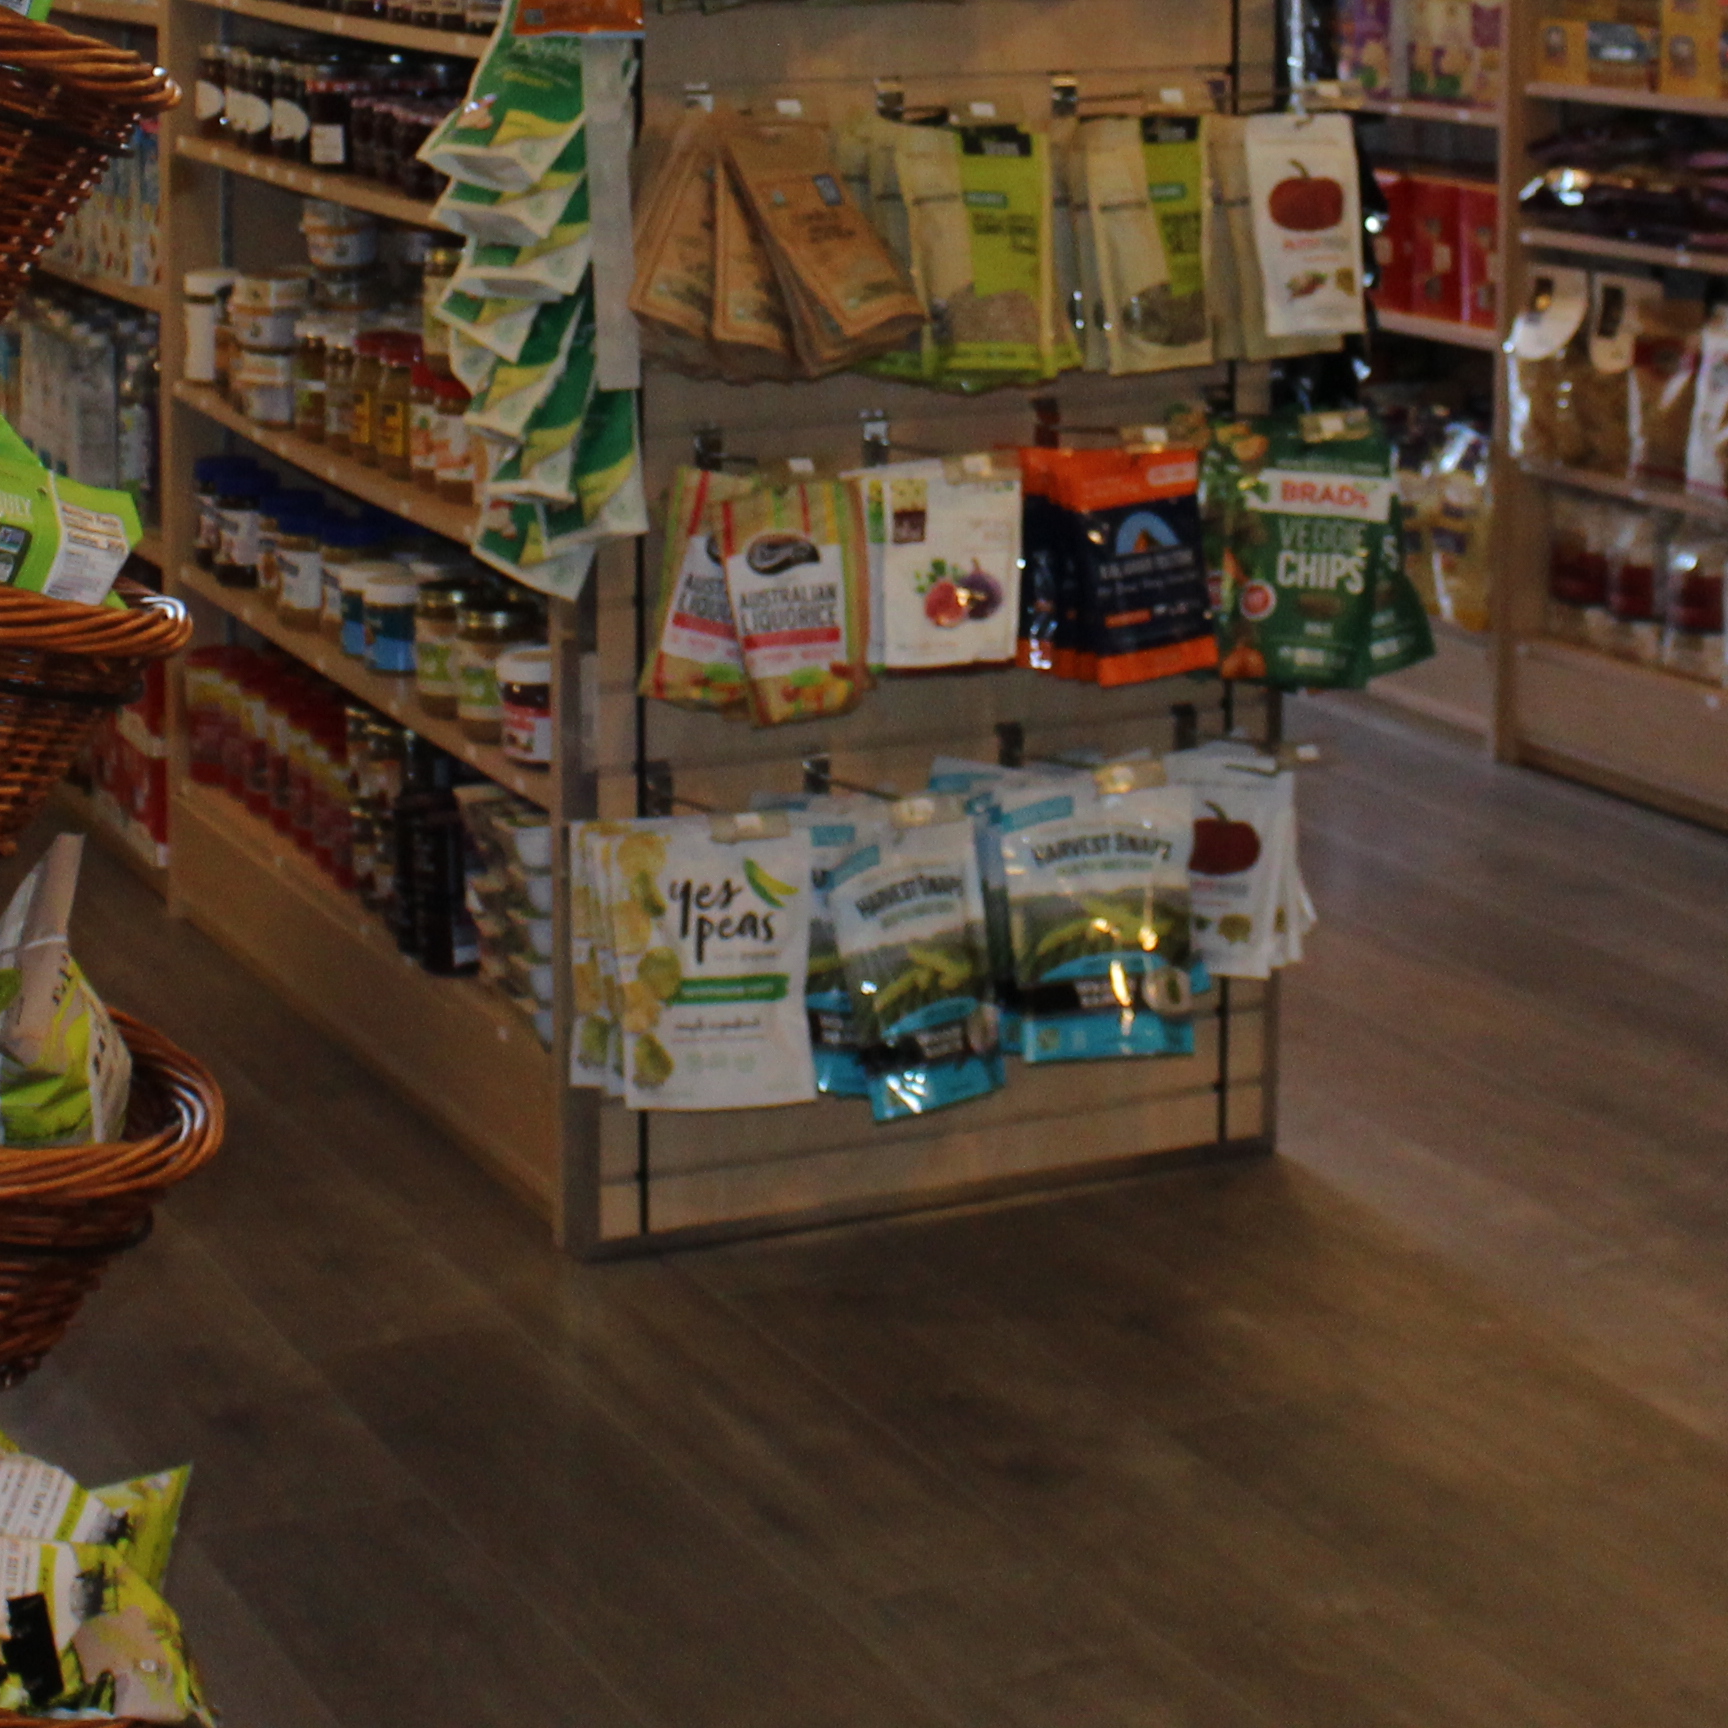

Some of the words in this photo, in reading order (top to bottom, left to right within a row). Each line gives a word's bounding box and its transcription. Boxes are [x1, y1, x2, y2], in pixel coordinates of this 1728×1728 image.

[1276, 518, 1369, 552] VEGGIE
[739, 582, 839, 608] AUSTRALIAN
[1276, 550, 1368, 596] CHIPS
[669, 877, 745, 942] yes
[695, 910, 777, 966] peas
